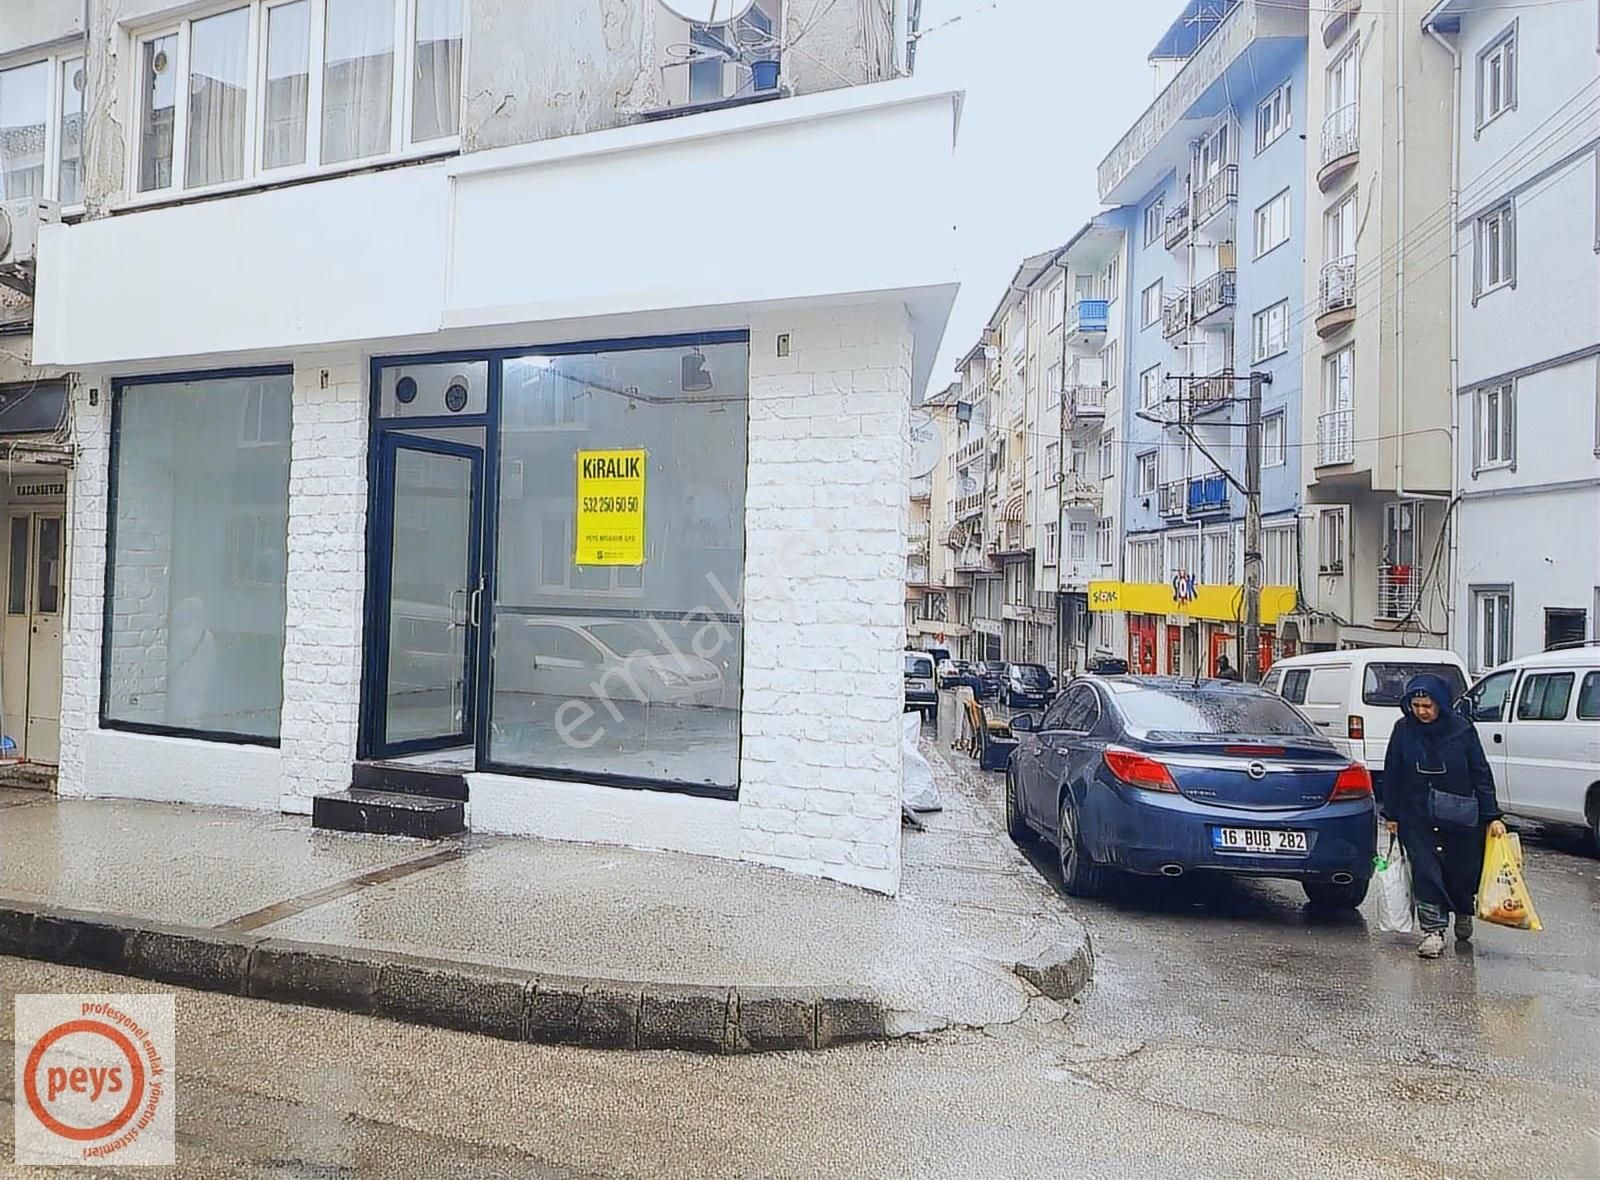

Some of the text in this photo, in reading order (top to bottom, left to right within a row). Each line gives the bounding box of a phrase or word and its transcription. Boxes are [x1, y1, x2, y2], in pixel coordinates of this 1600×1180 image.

[583, 496, 598, 513] 532
[1222, 829, 1305, 849] 16 BUB 282
